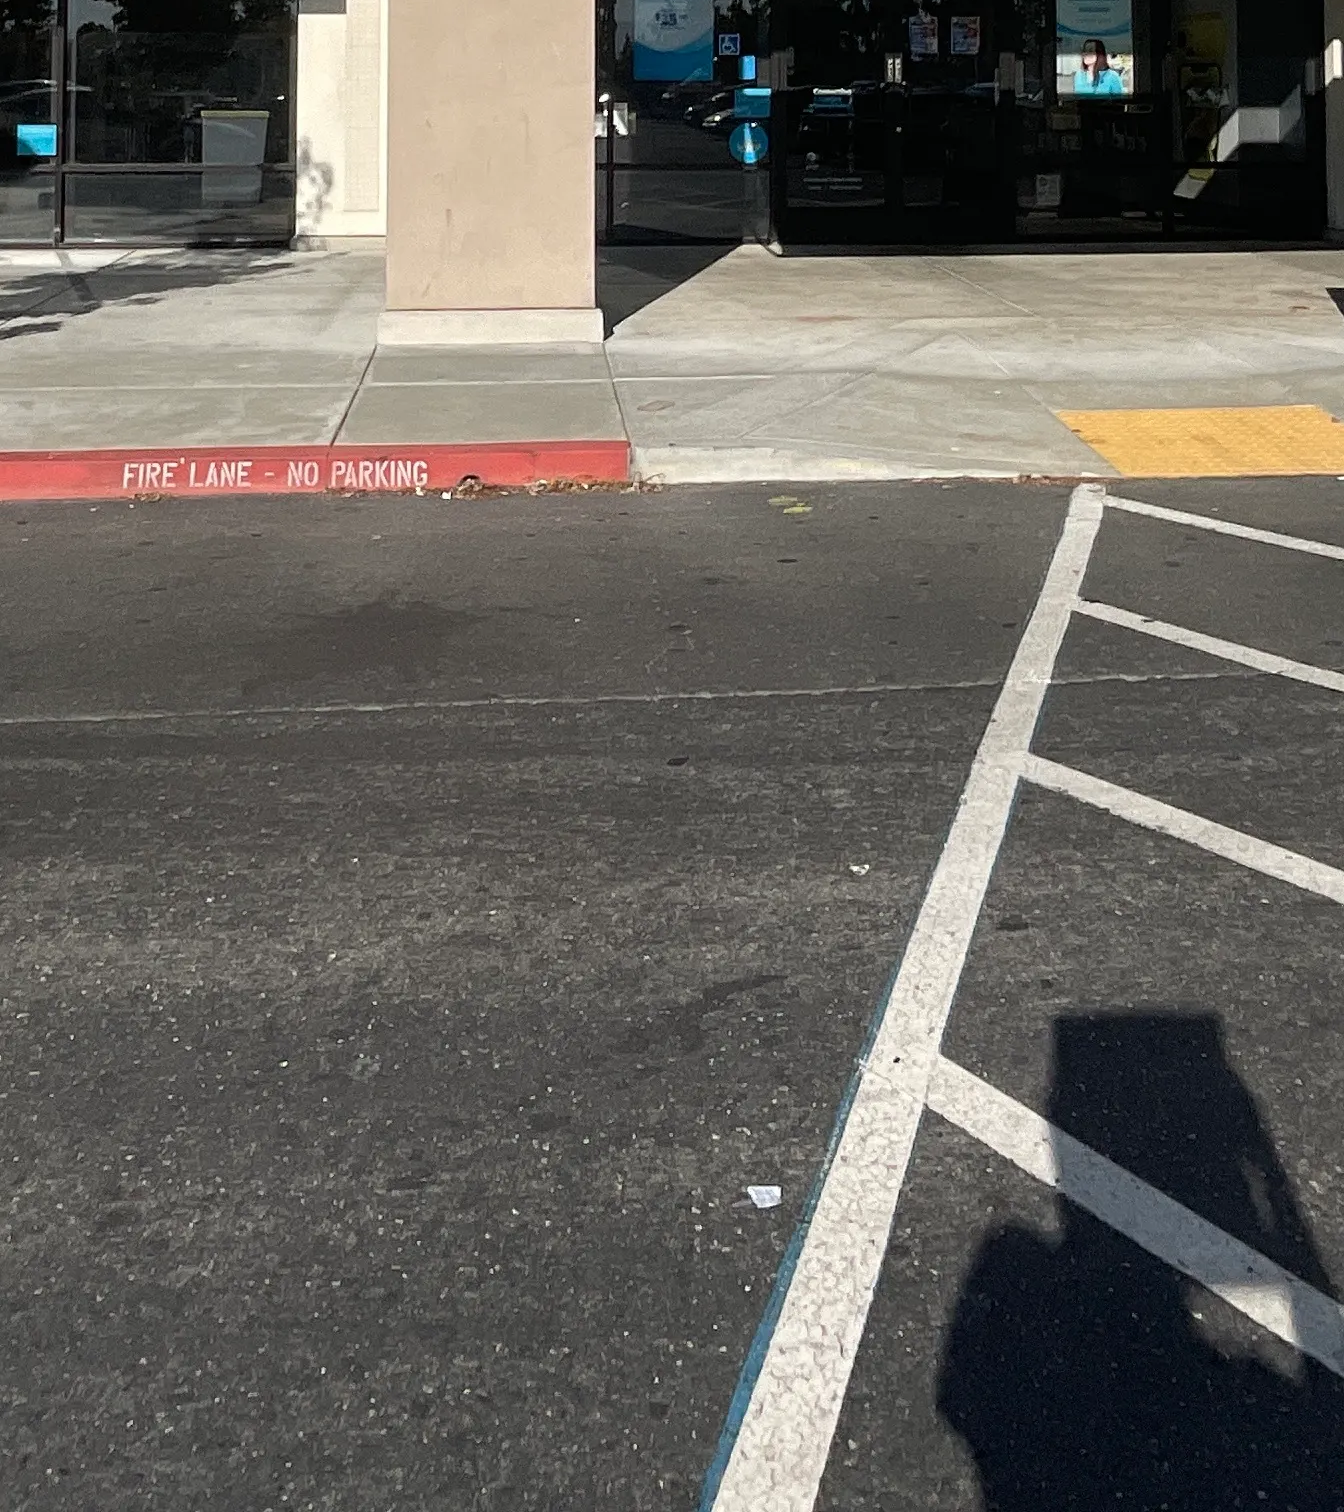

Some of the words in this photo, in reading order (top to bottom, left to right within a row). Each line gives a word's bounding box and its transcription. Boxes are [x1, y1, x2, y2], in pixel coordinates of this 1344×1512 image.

[123, 462, 179, 489] FIRE
[189, 461, 253, 488] LANE
[287, 461, 320, 488] NO
[330, 460, 429, 488] PARKING
